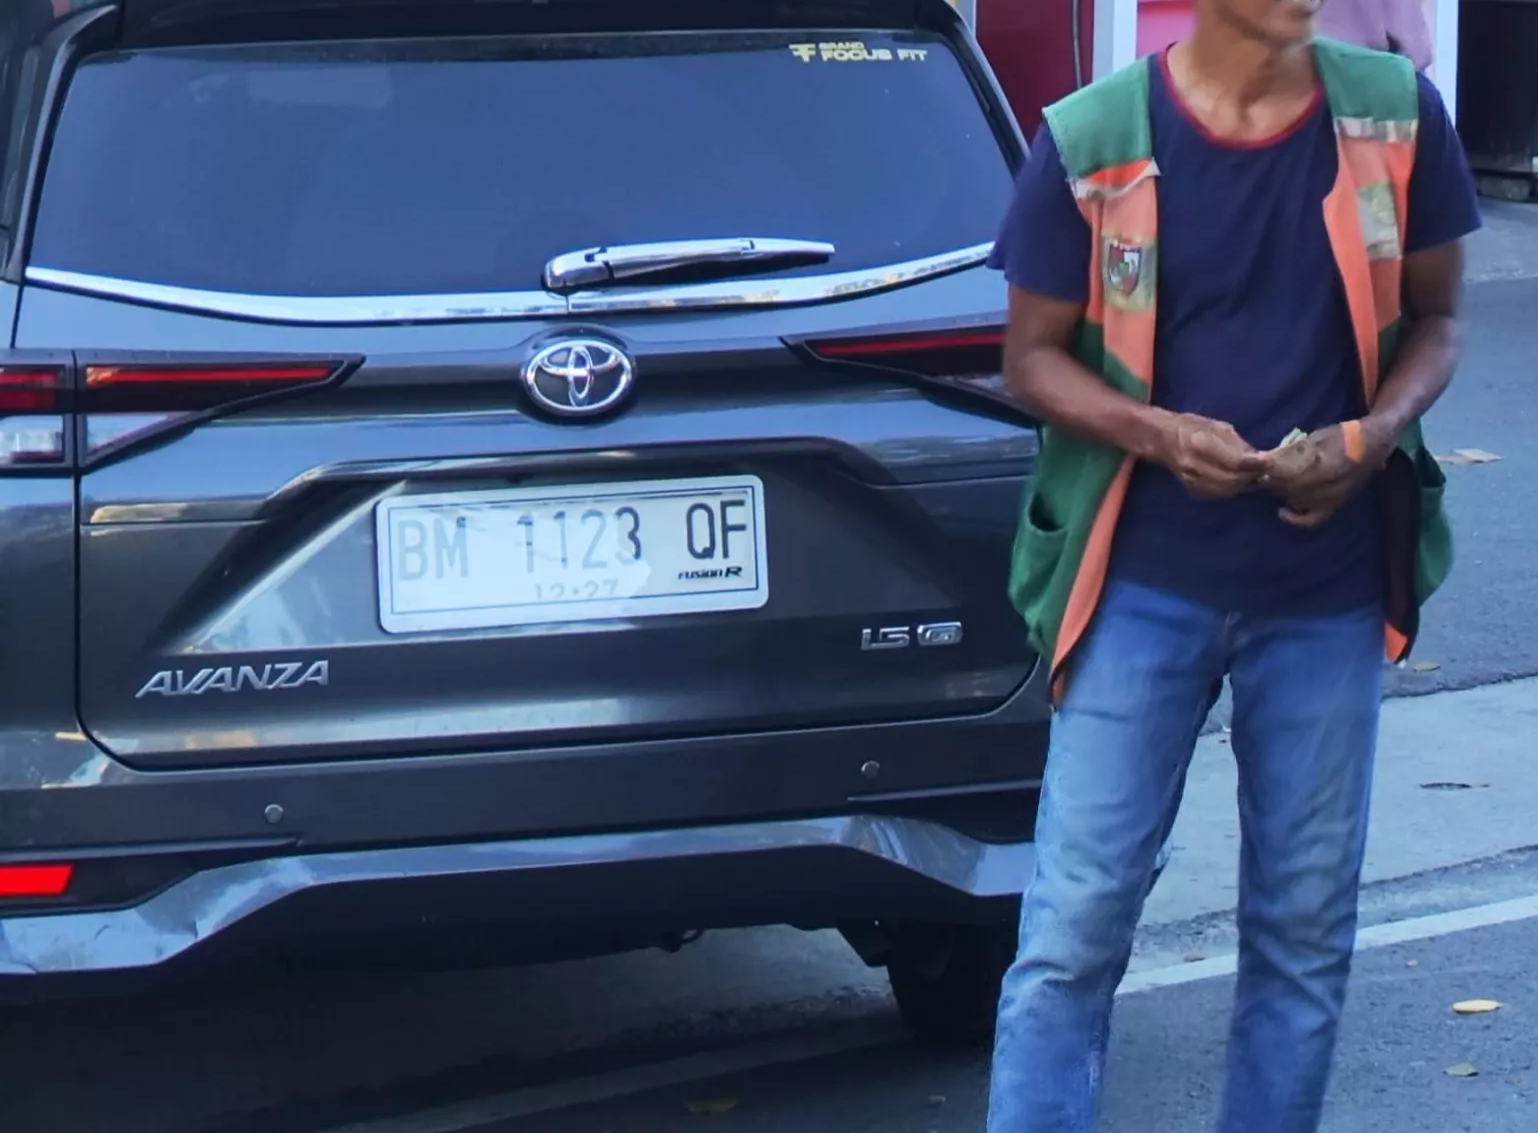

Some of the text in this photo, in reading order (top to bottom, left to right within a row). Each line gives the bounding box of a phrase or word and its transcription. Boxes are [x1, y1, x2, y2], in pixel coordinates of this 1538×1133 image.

[819, 48, 928, 62] FOCUS FIT
[399, 498, 748, 582] BM 1123 QF
[134, 659, 330, 698] AVANZA
